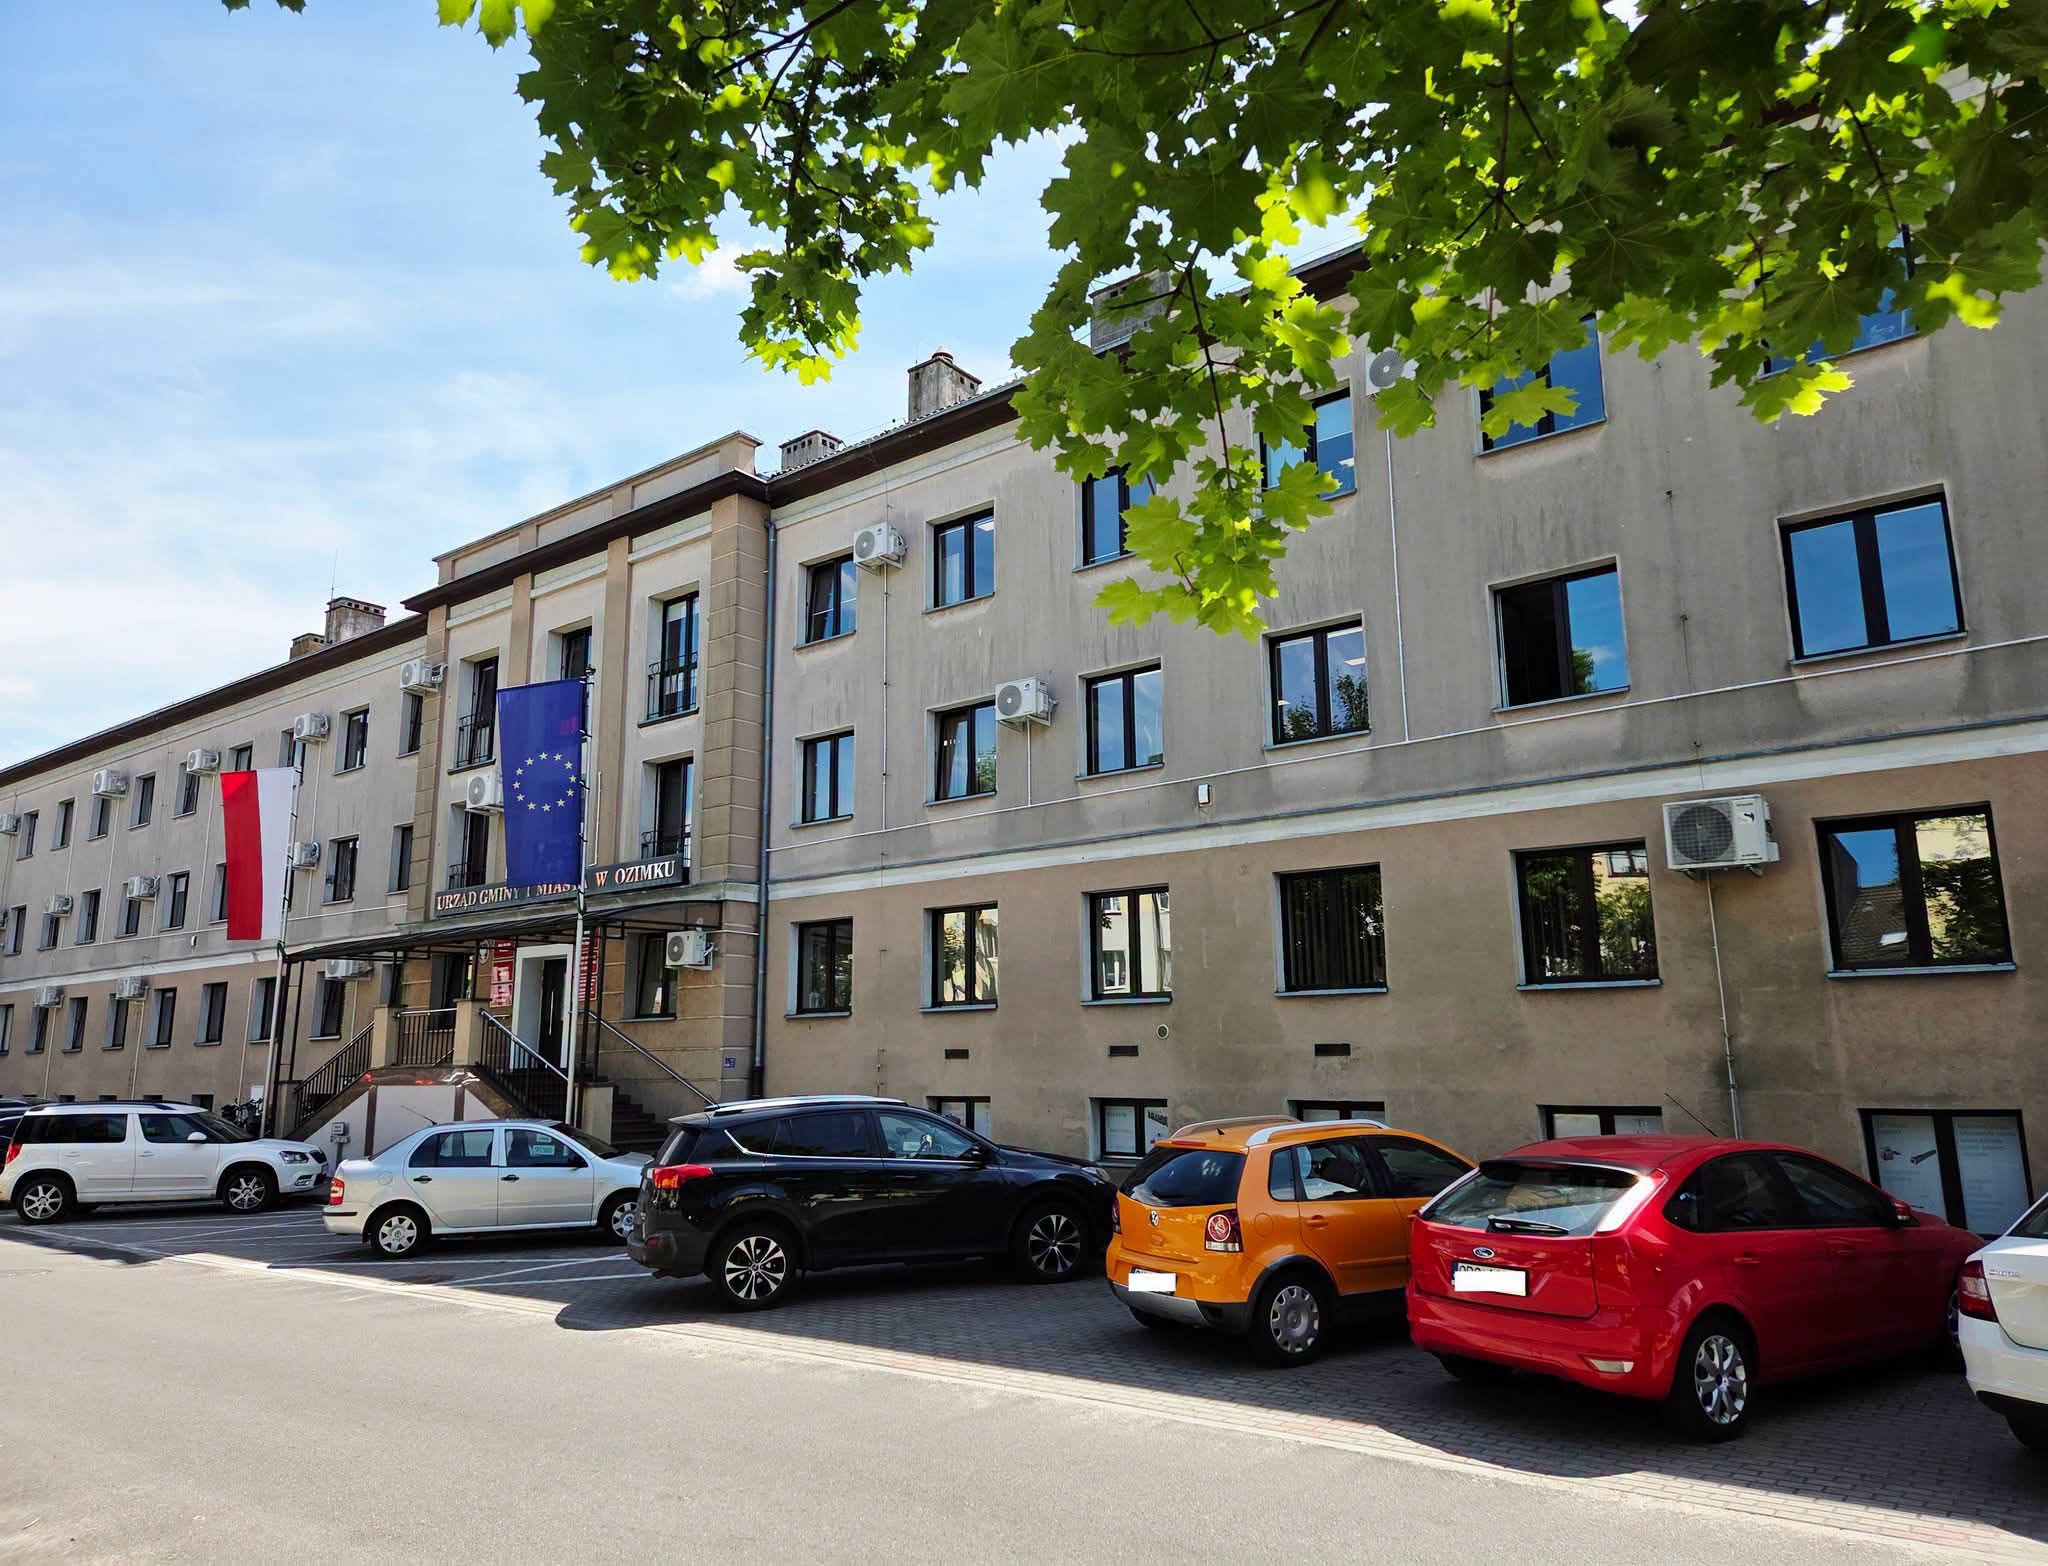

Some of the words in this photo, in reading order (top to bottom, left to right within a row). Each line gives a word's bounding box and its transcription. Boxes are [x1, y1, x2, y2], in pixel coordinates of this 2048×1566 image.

[437, 891, 477, 909] URZĄD
[480, 887, 519, 904] GMINY
[595, 871, 608, 888] W
[615, 860, 676, 884] OZIMKU
